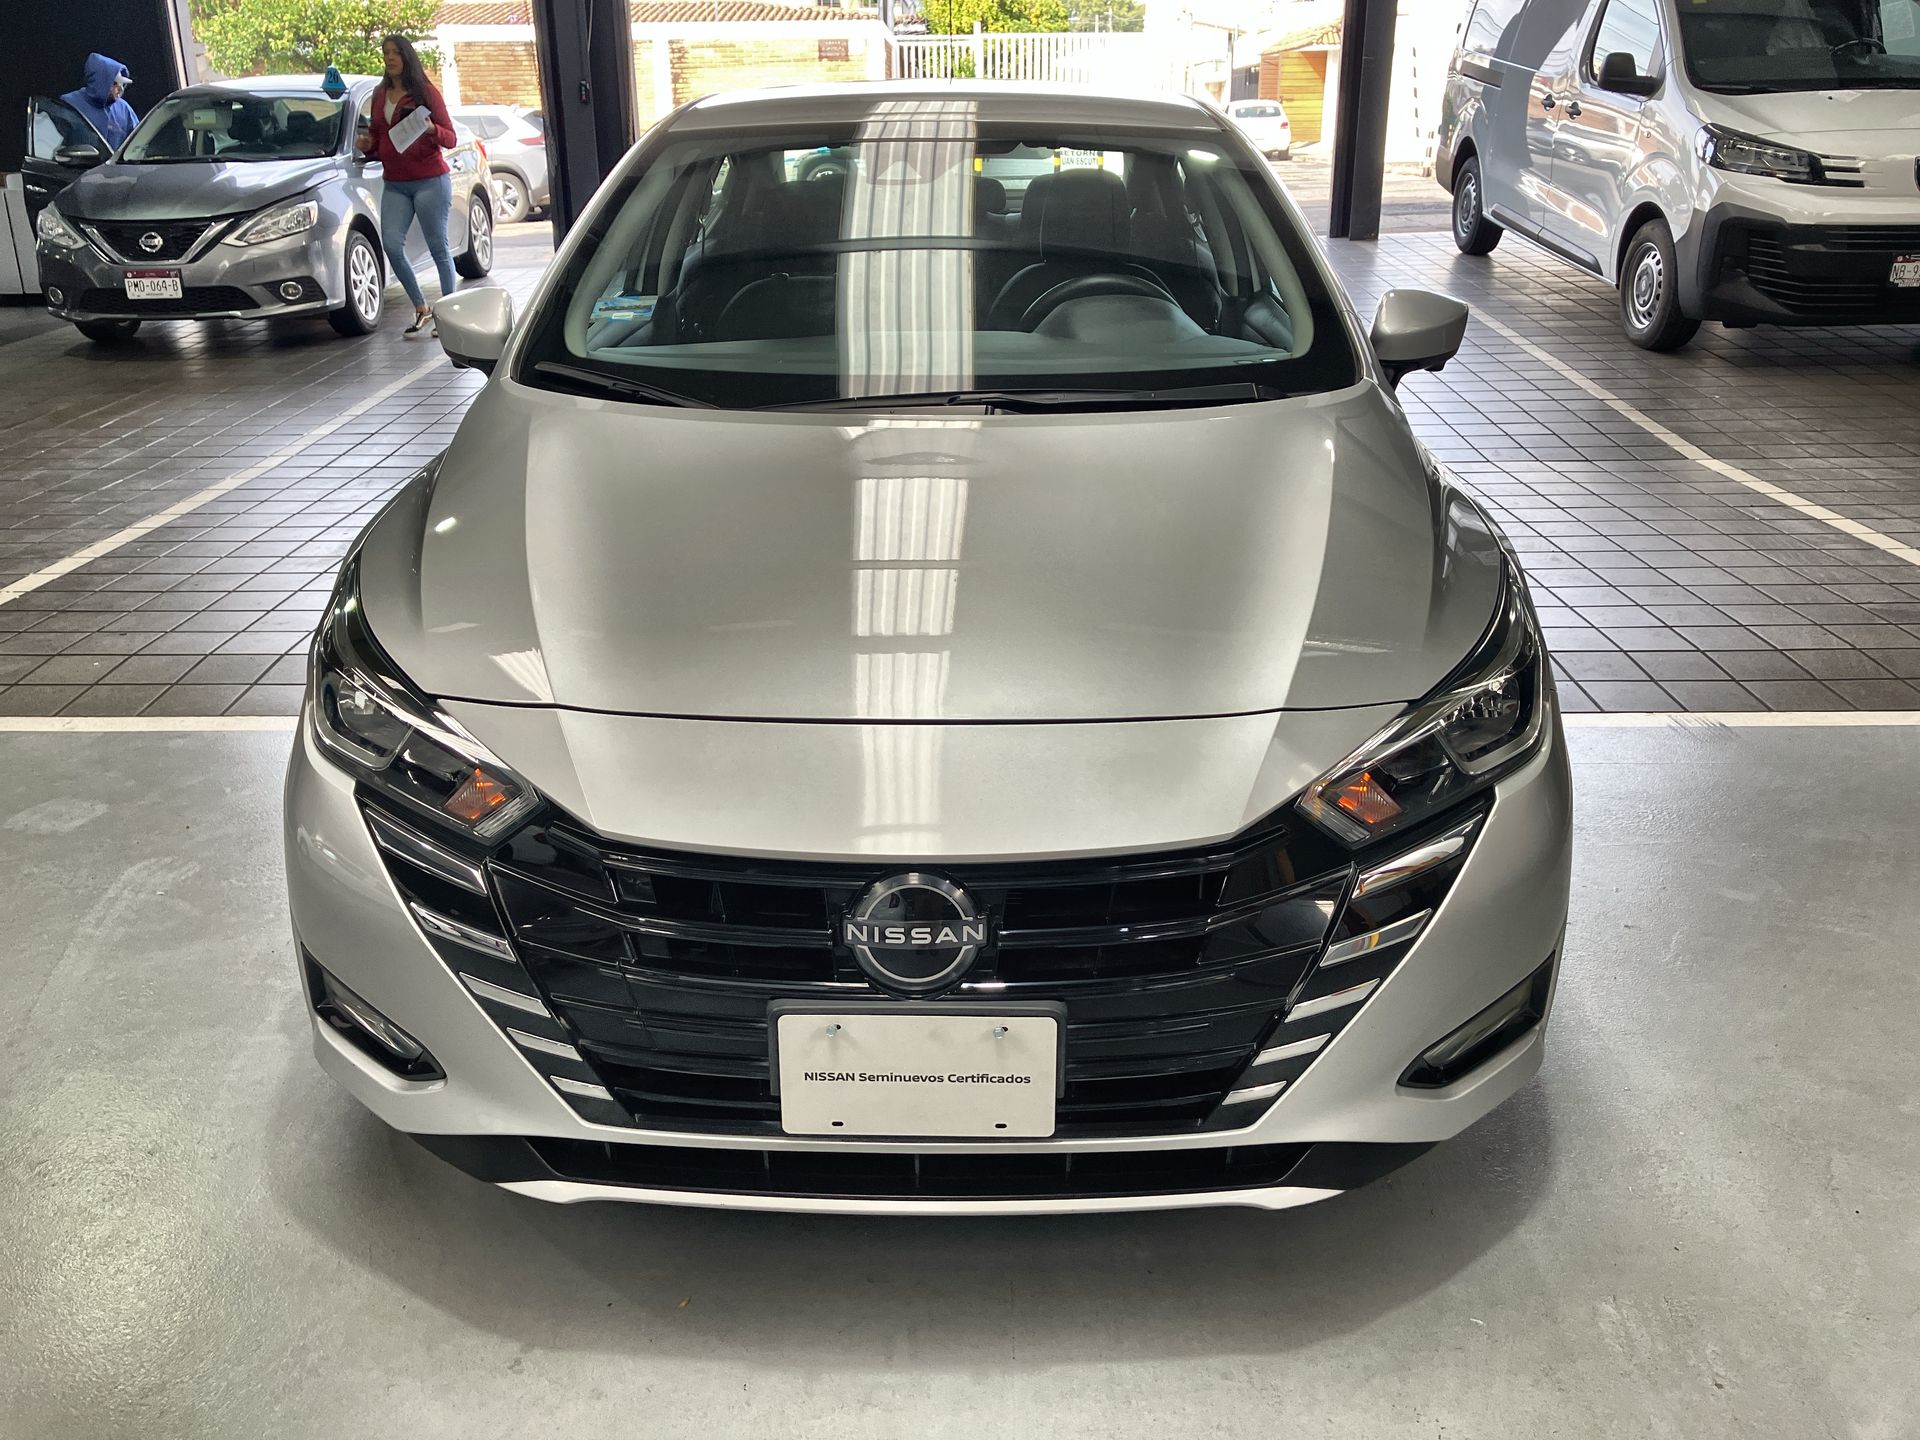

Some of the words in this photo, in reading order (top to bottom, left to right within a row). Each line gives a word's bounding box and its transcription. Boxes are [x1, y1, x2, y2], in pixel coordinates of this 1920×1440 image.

[1076, 157, 1097, 166] ESCUT
[1892, 264, 1920, 279] NB-9
[847, 923, 984, 945] NISSAN
[804, 1072, 856, 1082] NISSAN
[858, 1072, 945, 1083] Seminuevos
[947, 1073, 1032, 1084] Certificados
